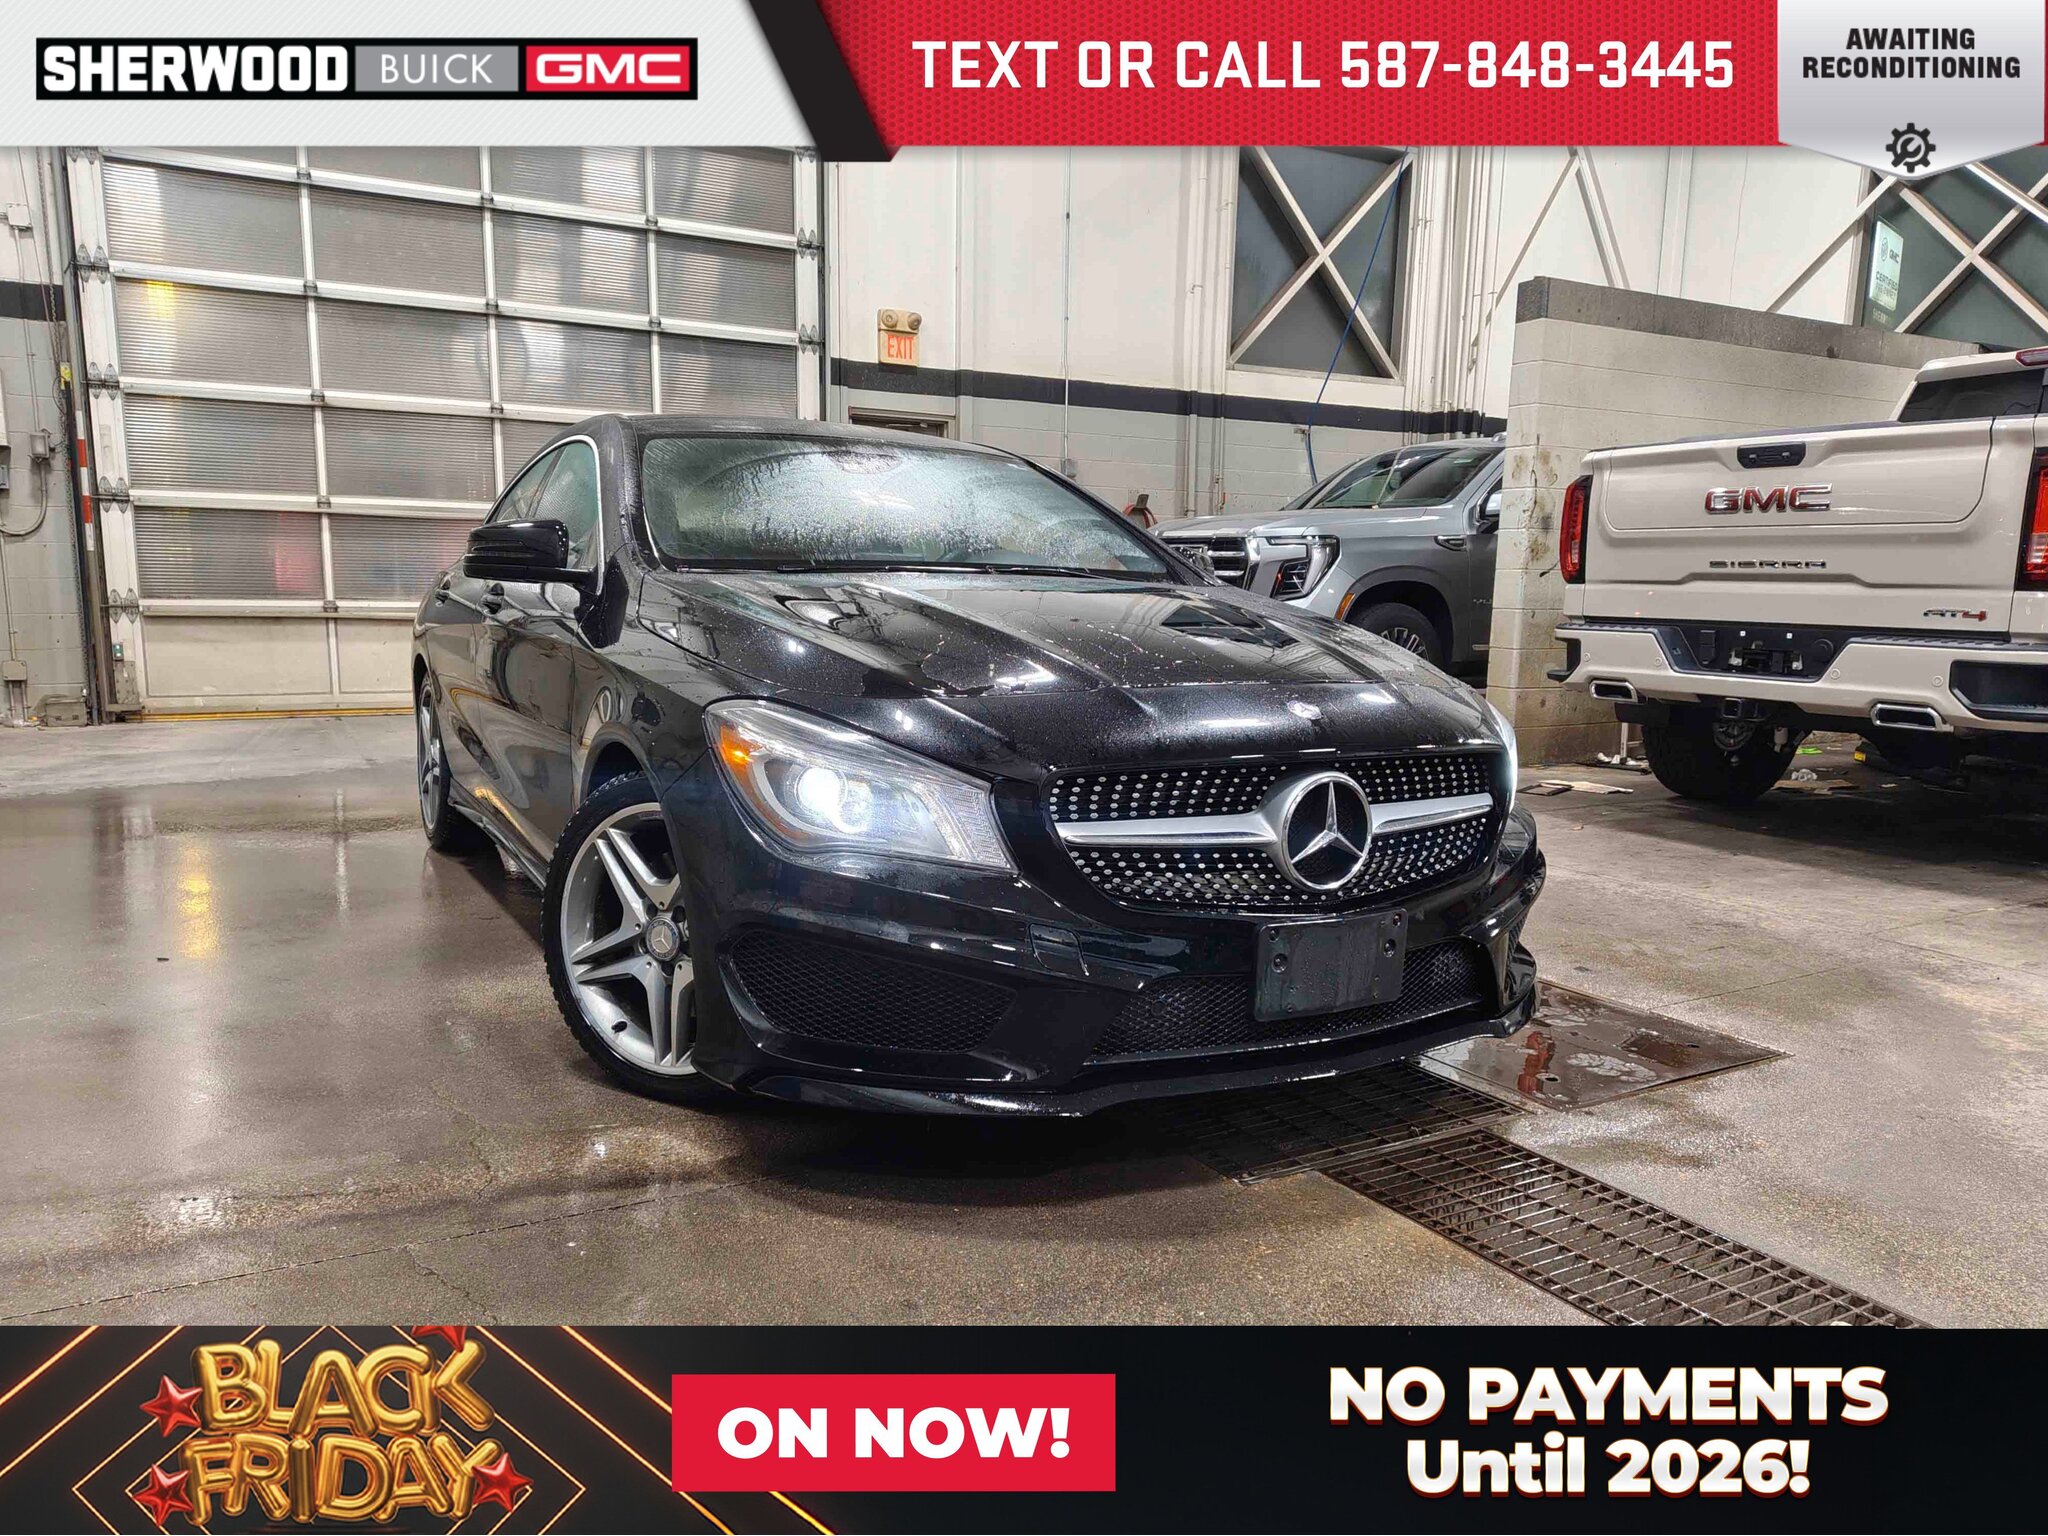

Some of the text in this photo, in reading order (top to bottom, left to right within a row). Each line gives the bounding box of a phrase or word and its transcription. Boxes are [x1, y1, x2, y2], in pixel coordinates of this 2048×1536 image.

[887, 335, 914, 360] EXIT
[1705, 483, 1833, 514] GMC
[1709, 559, 1827, 569] SIERRA
[1923, 608, 1988, 622] AT4
